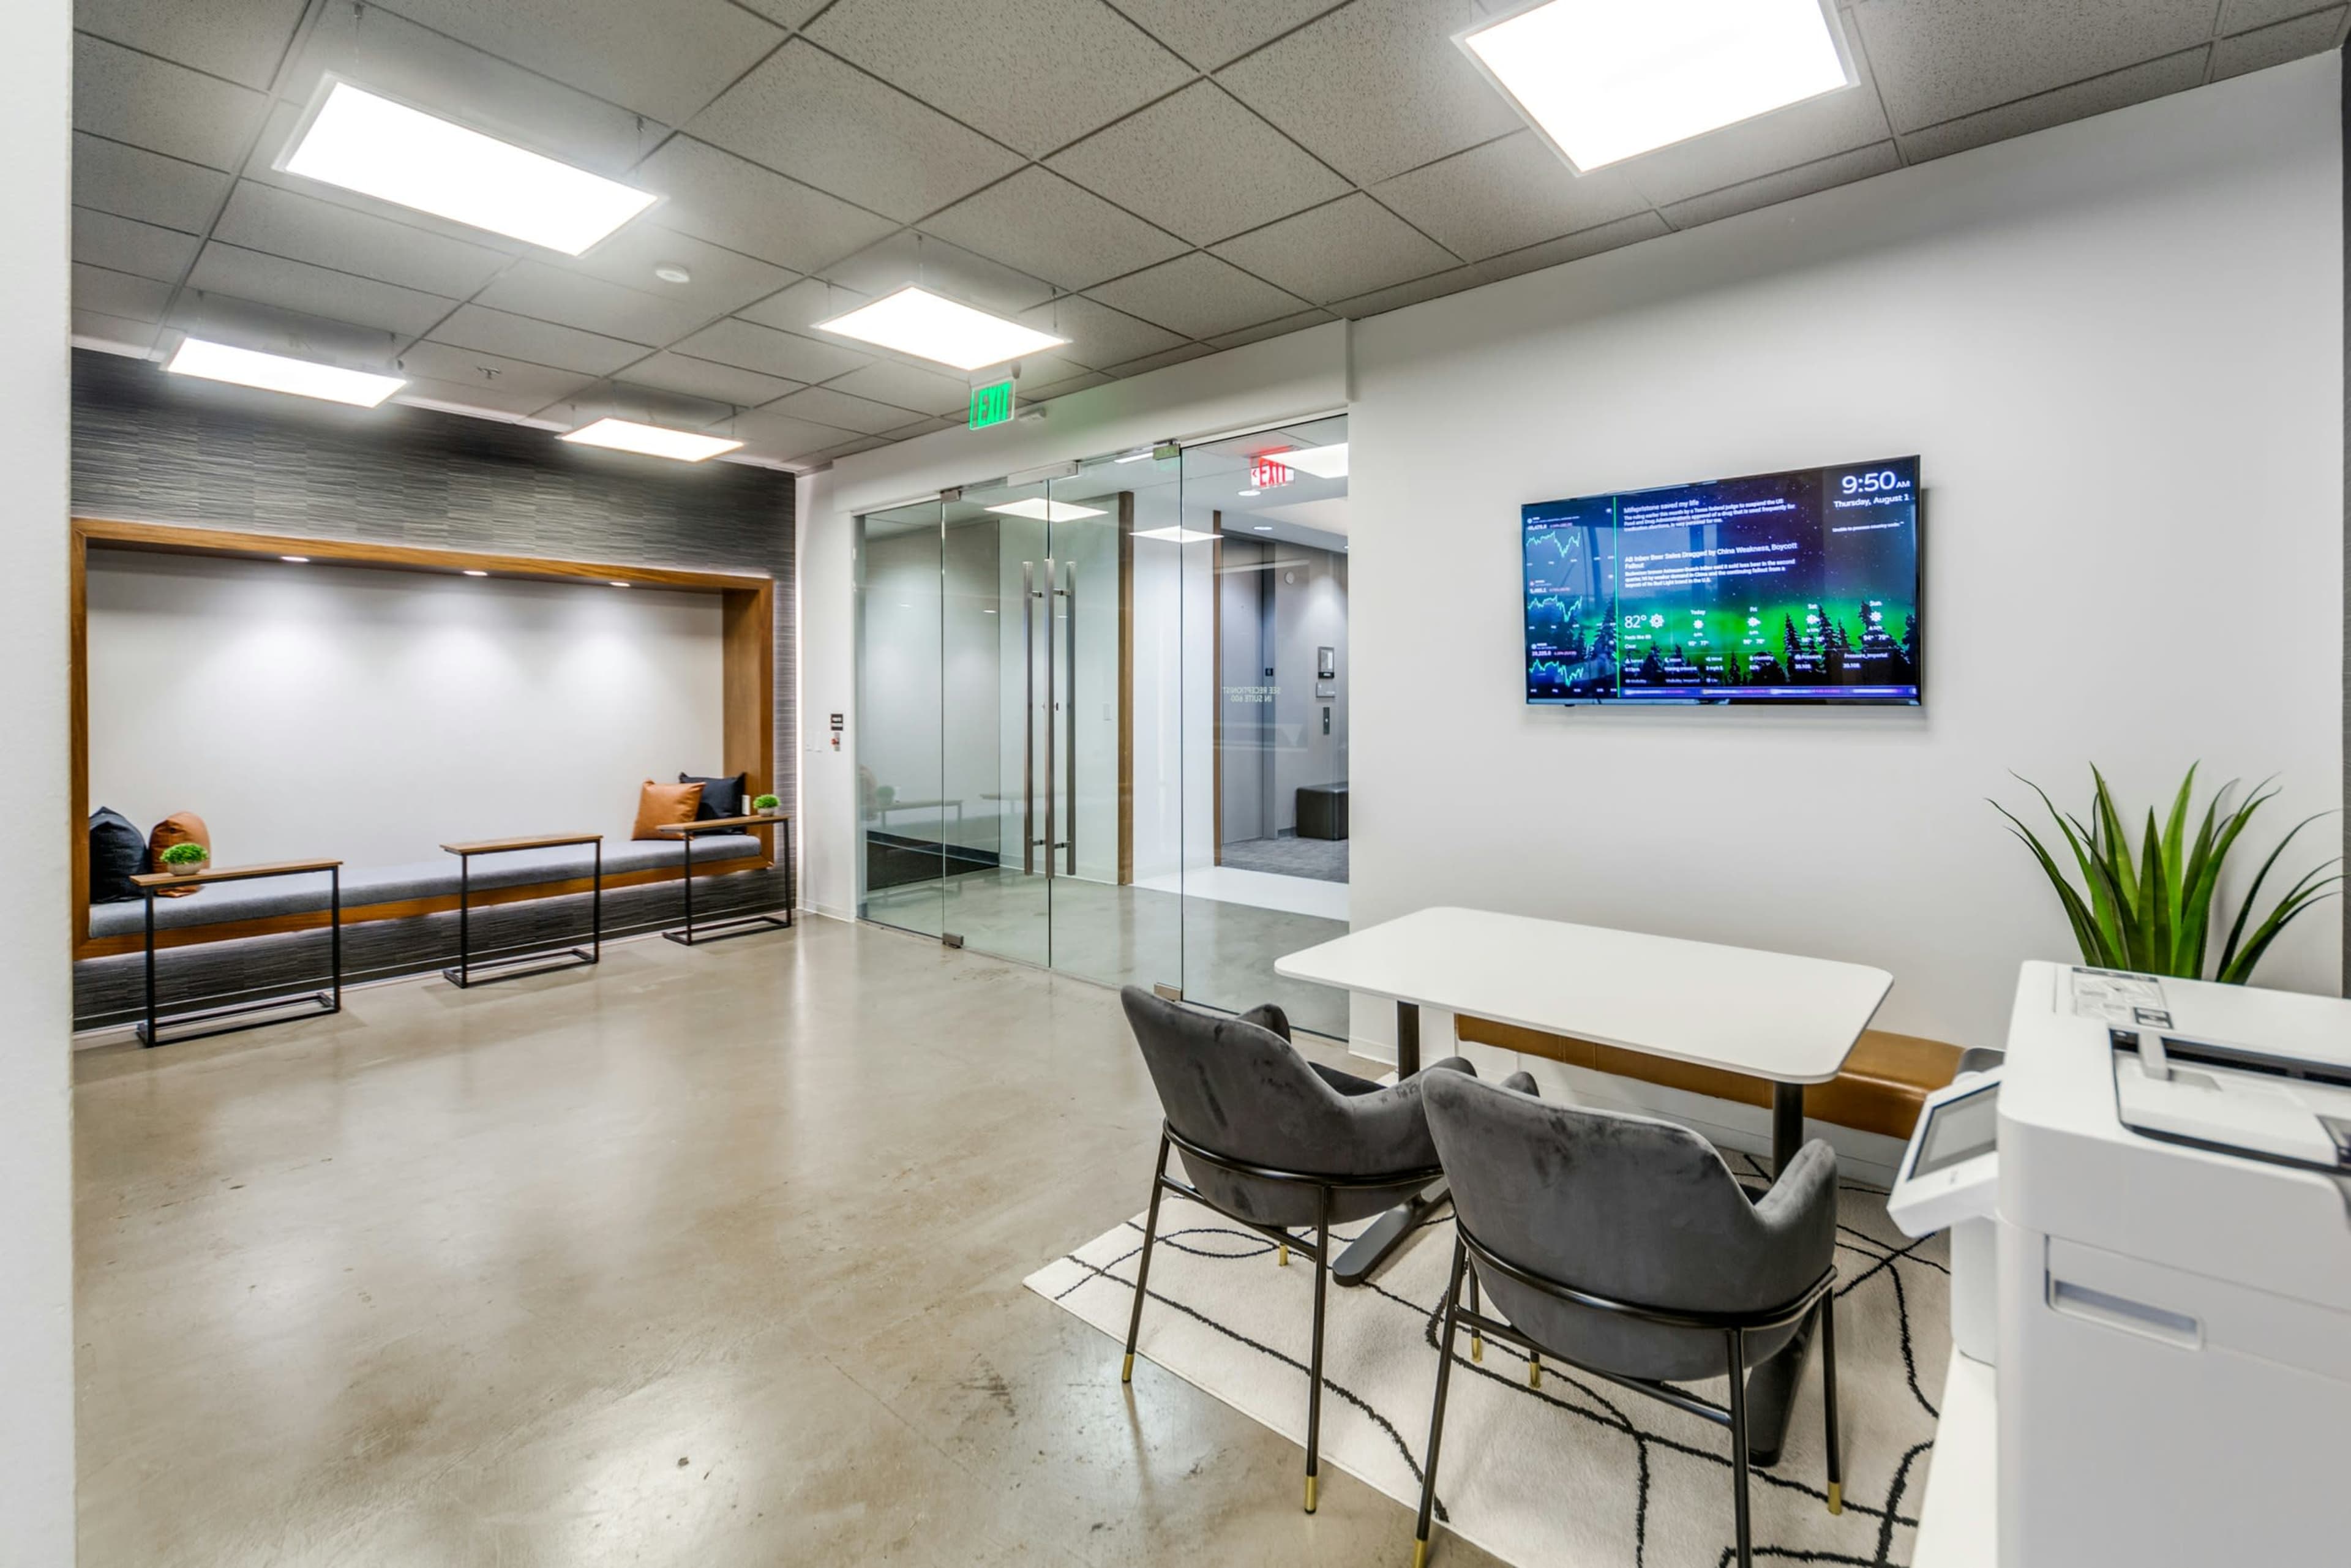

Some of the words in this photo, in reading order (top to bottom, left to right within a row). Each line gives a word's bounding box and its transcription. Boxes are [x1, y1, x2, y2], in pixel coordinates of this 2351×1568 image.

[978, 381, 1011, 427] EXIT
[1259, 458, 1286, 487] EXIT
[1842, 471, 1896, 494] 9:50
[1834, 498, 1872, 508] Thursday,
[1873, 495, 1903, 505] August
[1681, 549, 1708, 558] Dragged
[1708, 549, 1716, 557] by
[1771, 542, 1798, 551] Boycott
[1624, 614, 1648, 629] 82°
